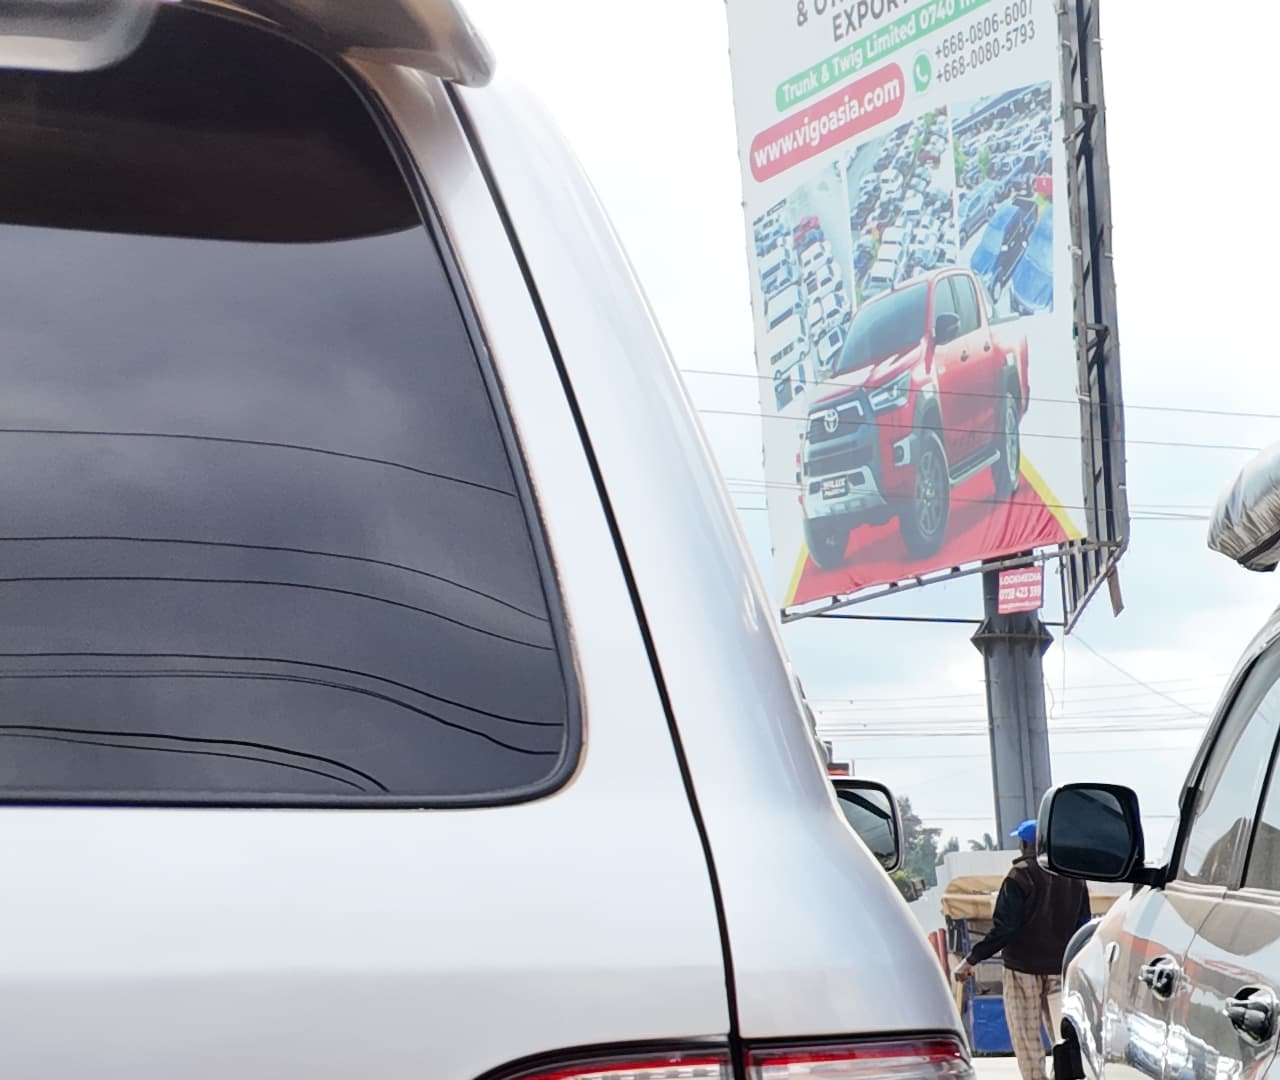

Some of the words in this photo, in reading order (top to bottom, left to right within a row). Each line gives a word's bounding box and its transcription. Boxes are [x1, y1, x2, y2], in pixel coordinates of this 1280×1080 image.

[782, 71, 818, 103] Trunk
[820, 63, 830, 84] &
[832, 48, 863, 76] Twig
[867, 14, 915, 58] Limited
[936, 19, 1036, 84] +668-0080-5793
[754, 78, 900, 168] www.vigoasia.com
